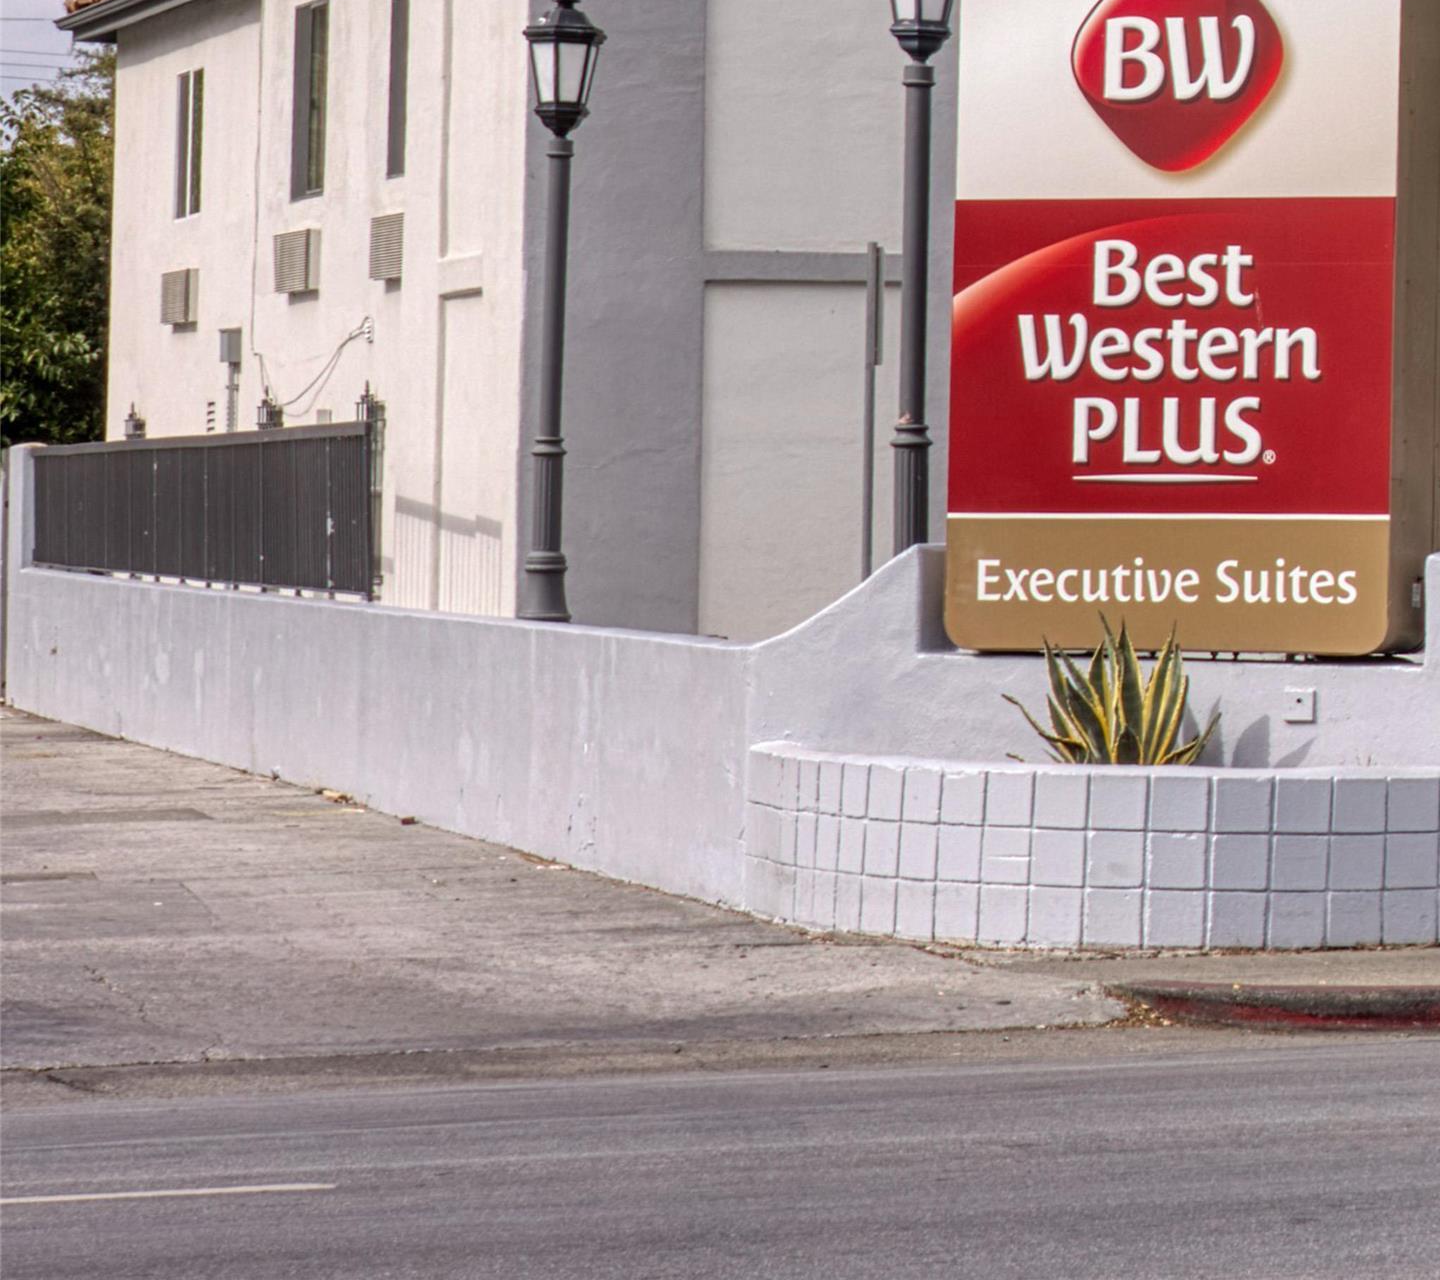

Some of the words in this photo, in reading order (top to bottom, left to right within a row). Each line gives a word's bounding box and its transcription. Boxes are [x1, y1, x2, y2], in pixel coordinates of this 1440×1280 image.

[1102, 14, 1257, 103] BW
[1093, 239, 1254, 307] Best
[1017, 313, 1322, 381] Western
[1072, 396, 1261, 465] PLUS
[976, 556, 1200, 603] Executive
[1215, 557, 1358, 605] Suites
